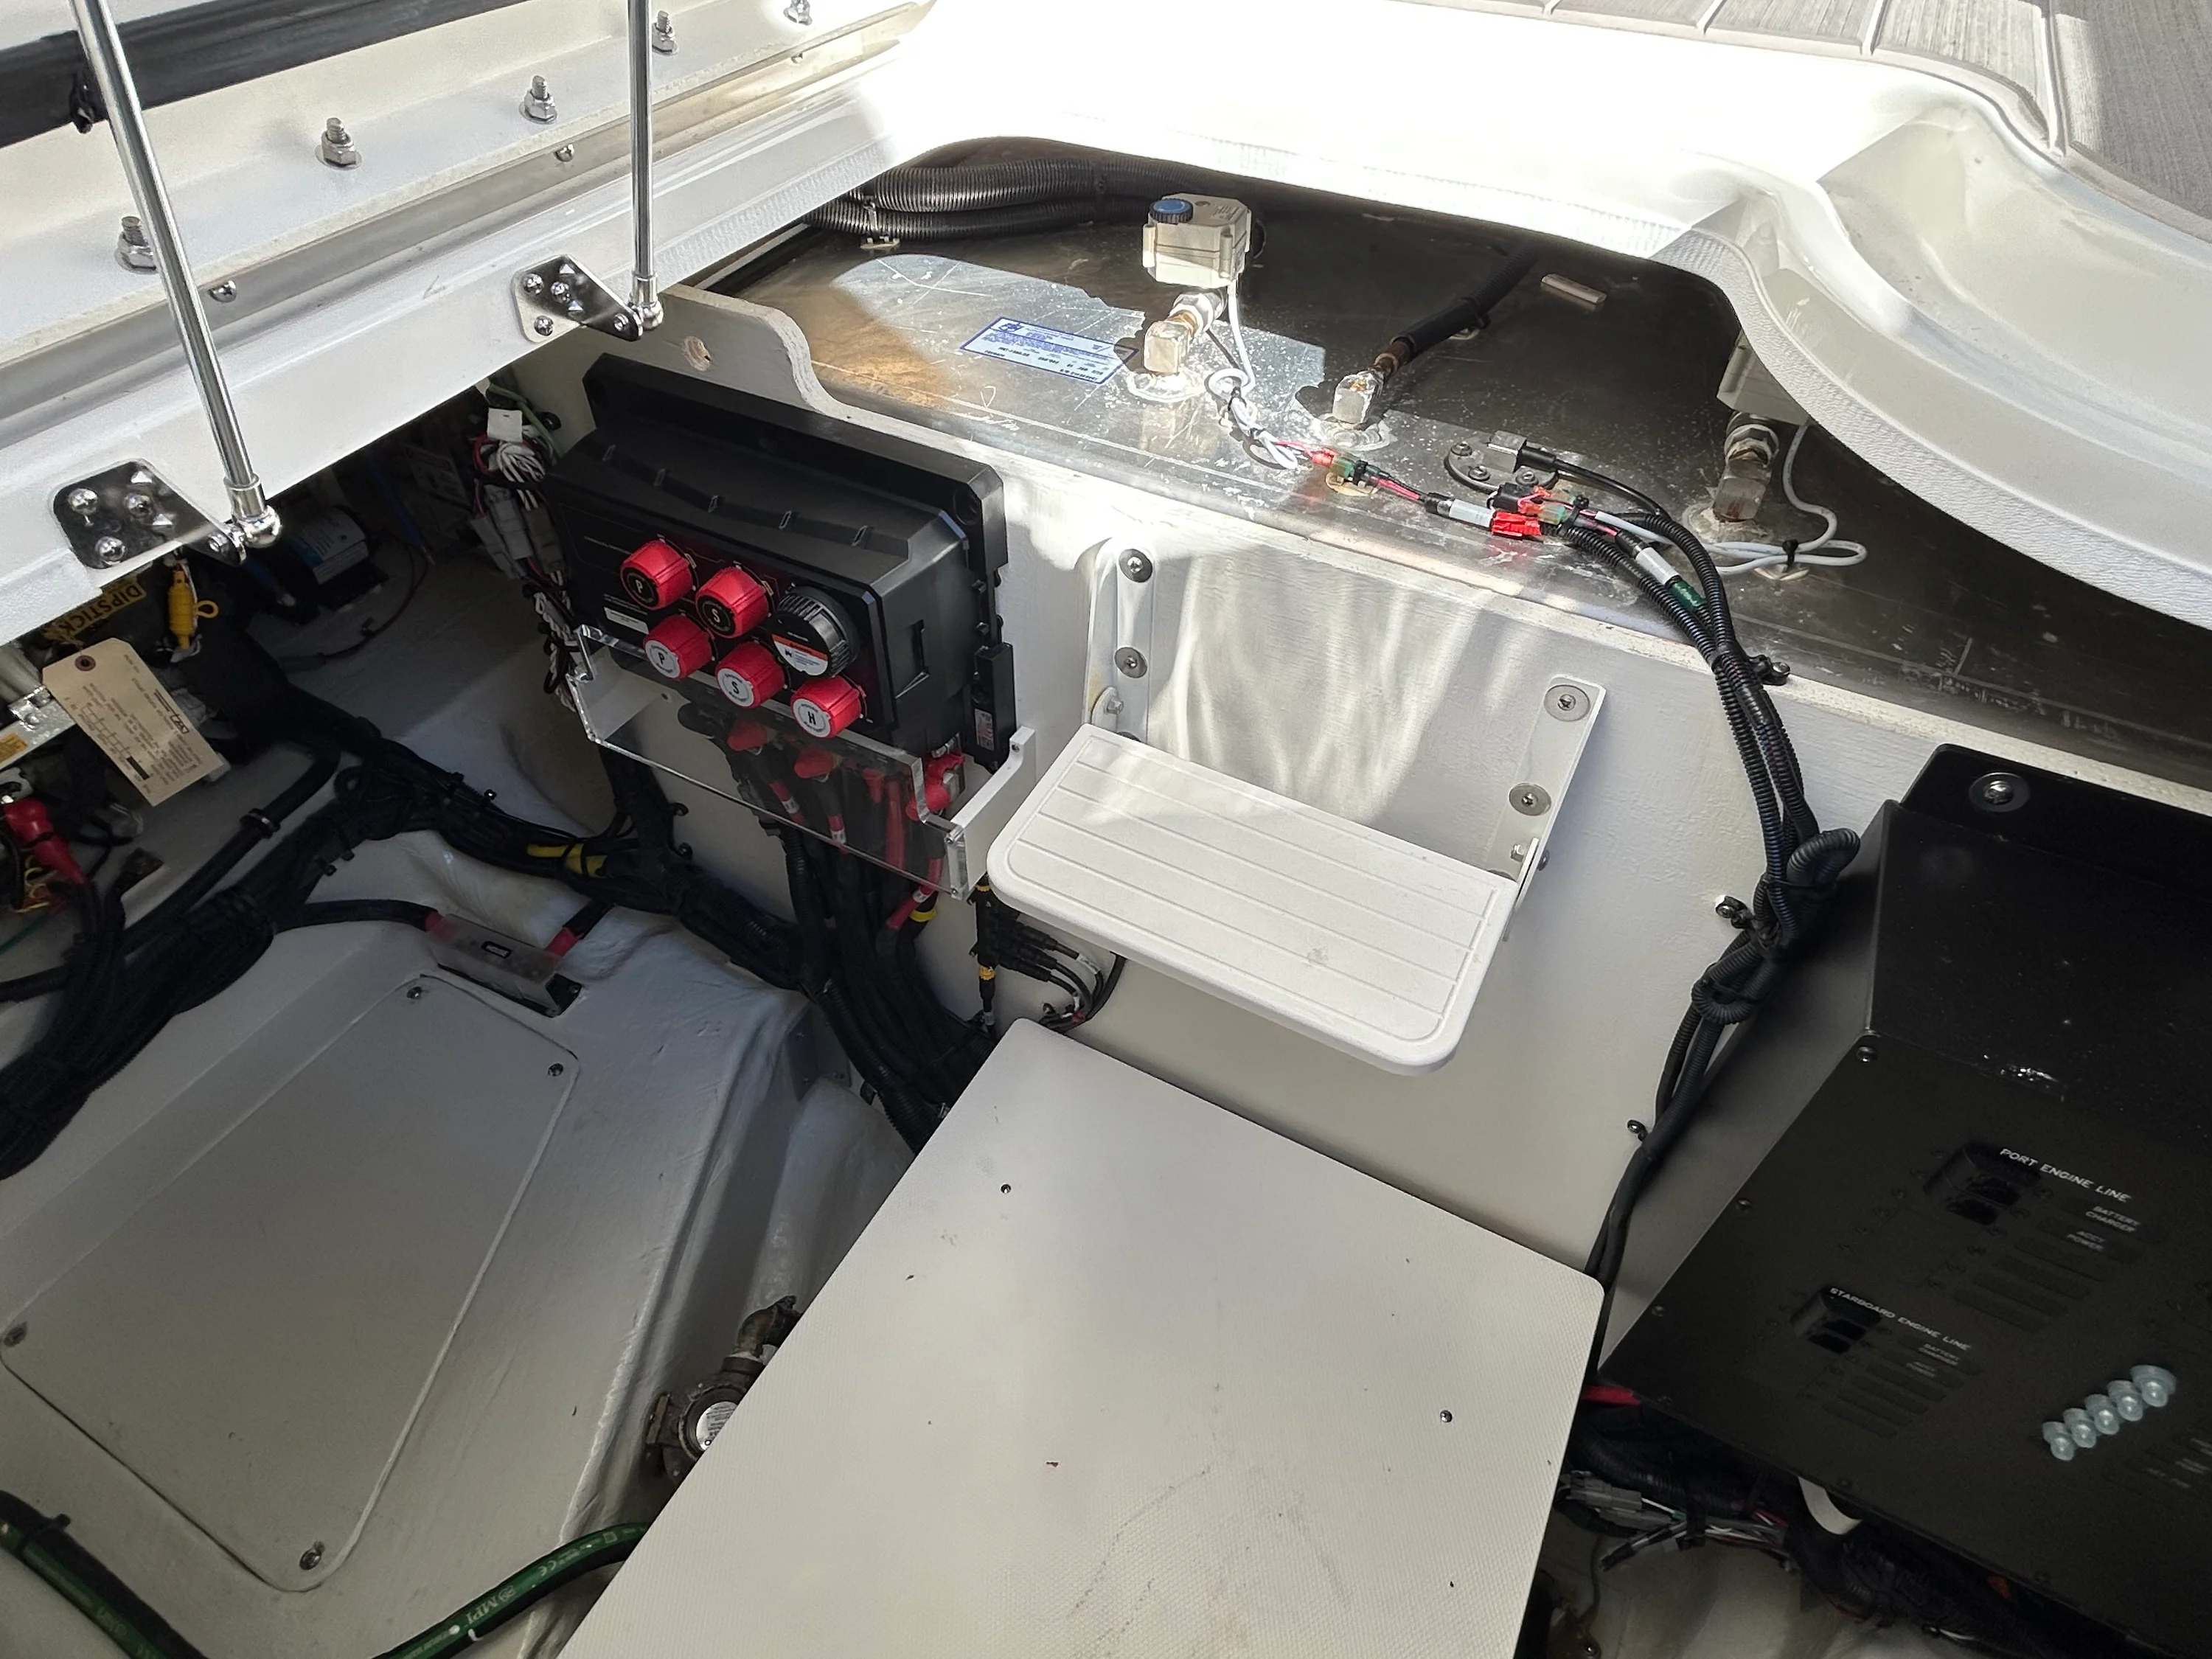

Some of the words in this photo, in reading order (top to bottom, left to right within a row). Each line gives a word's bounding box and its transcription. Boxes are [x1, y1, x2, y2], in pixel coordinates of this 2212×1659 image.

[636, 579, 644, 594] P
[59, 585, 142, 635] DIPSTICK
[712, 608, 720, 623] S
[658, 652, 665, 665] P
[731, 681, 740, 695] S
[807, 711, 816, 726] H
[2000, 1148, 2038, 1166] PORT
[2039, 1164, 2094, 1189] ENGINE
[2096, 1186, 2132, 1203] LINE
[1830, 1287, 1896, 1318] STARBOARD
[1898, 1317, 1941, 1338] ENGINE
[1942, 1336, 1972, 1351] LINE
[465, 1596, 499, 1624] MPI
